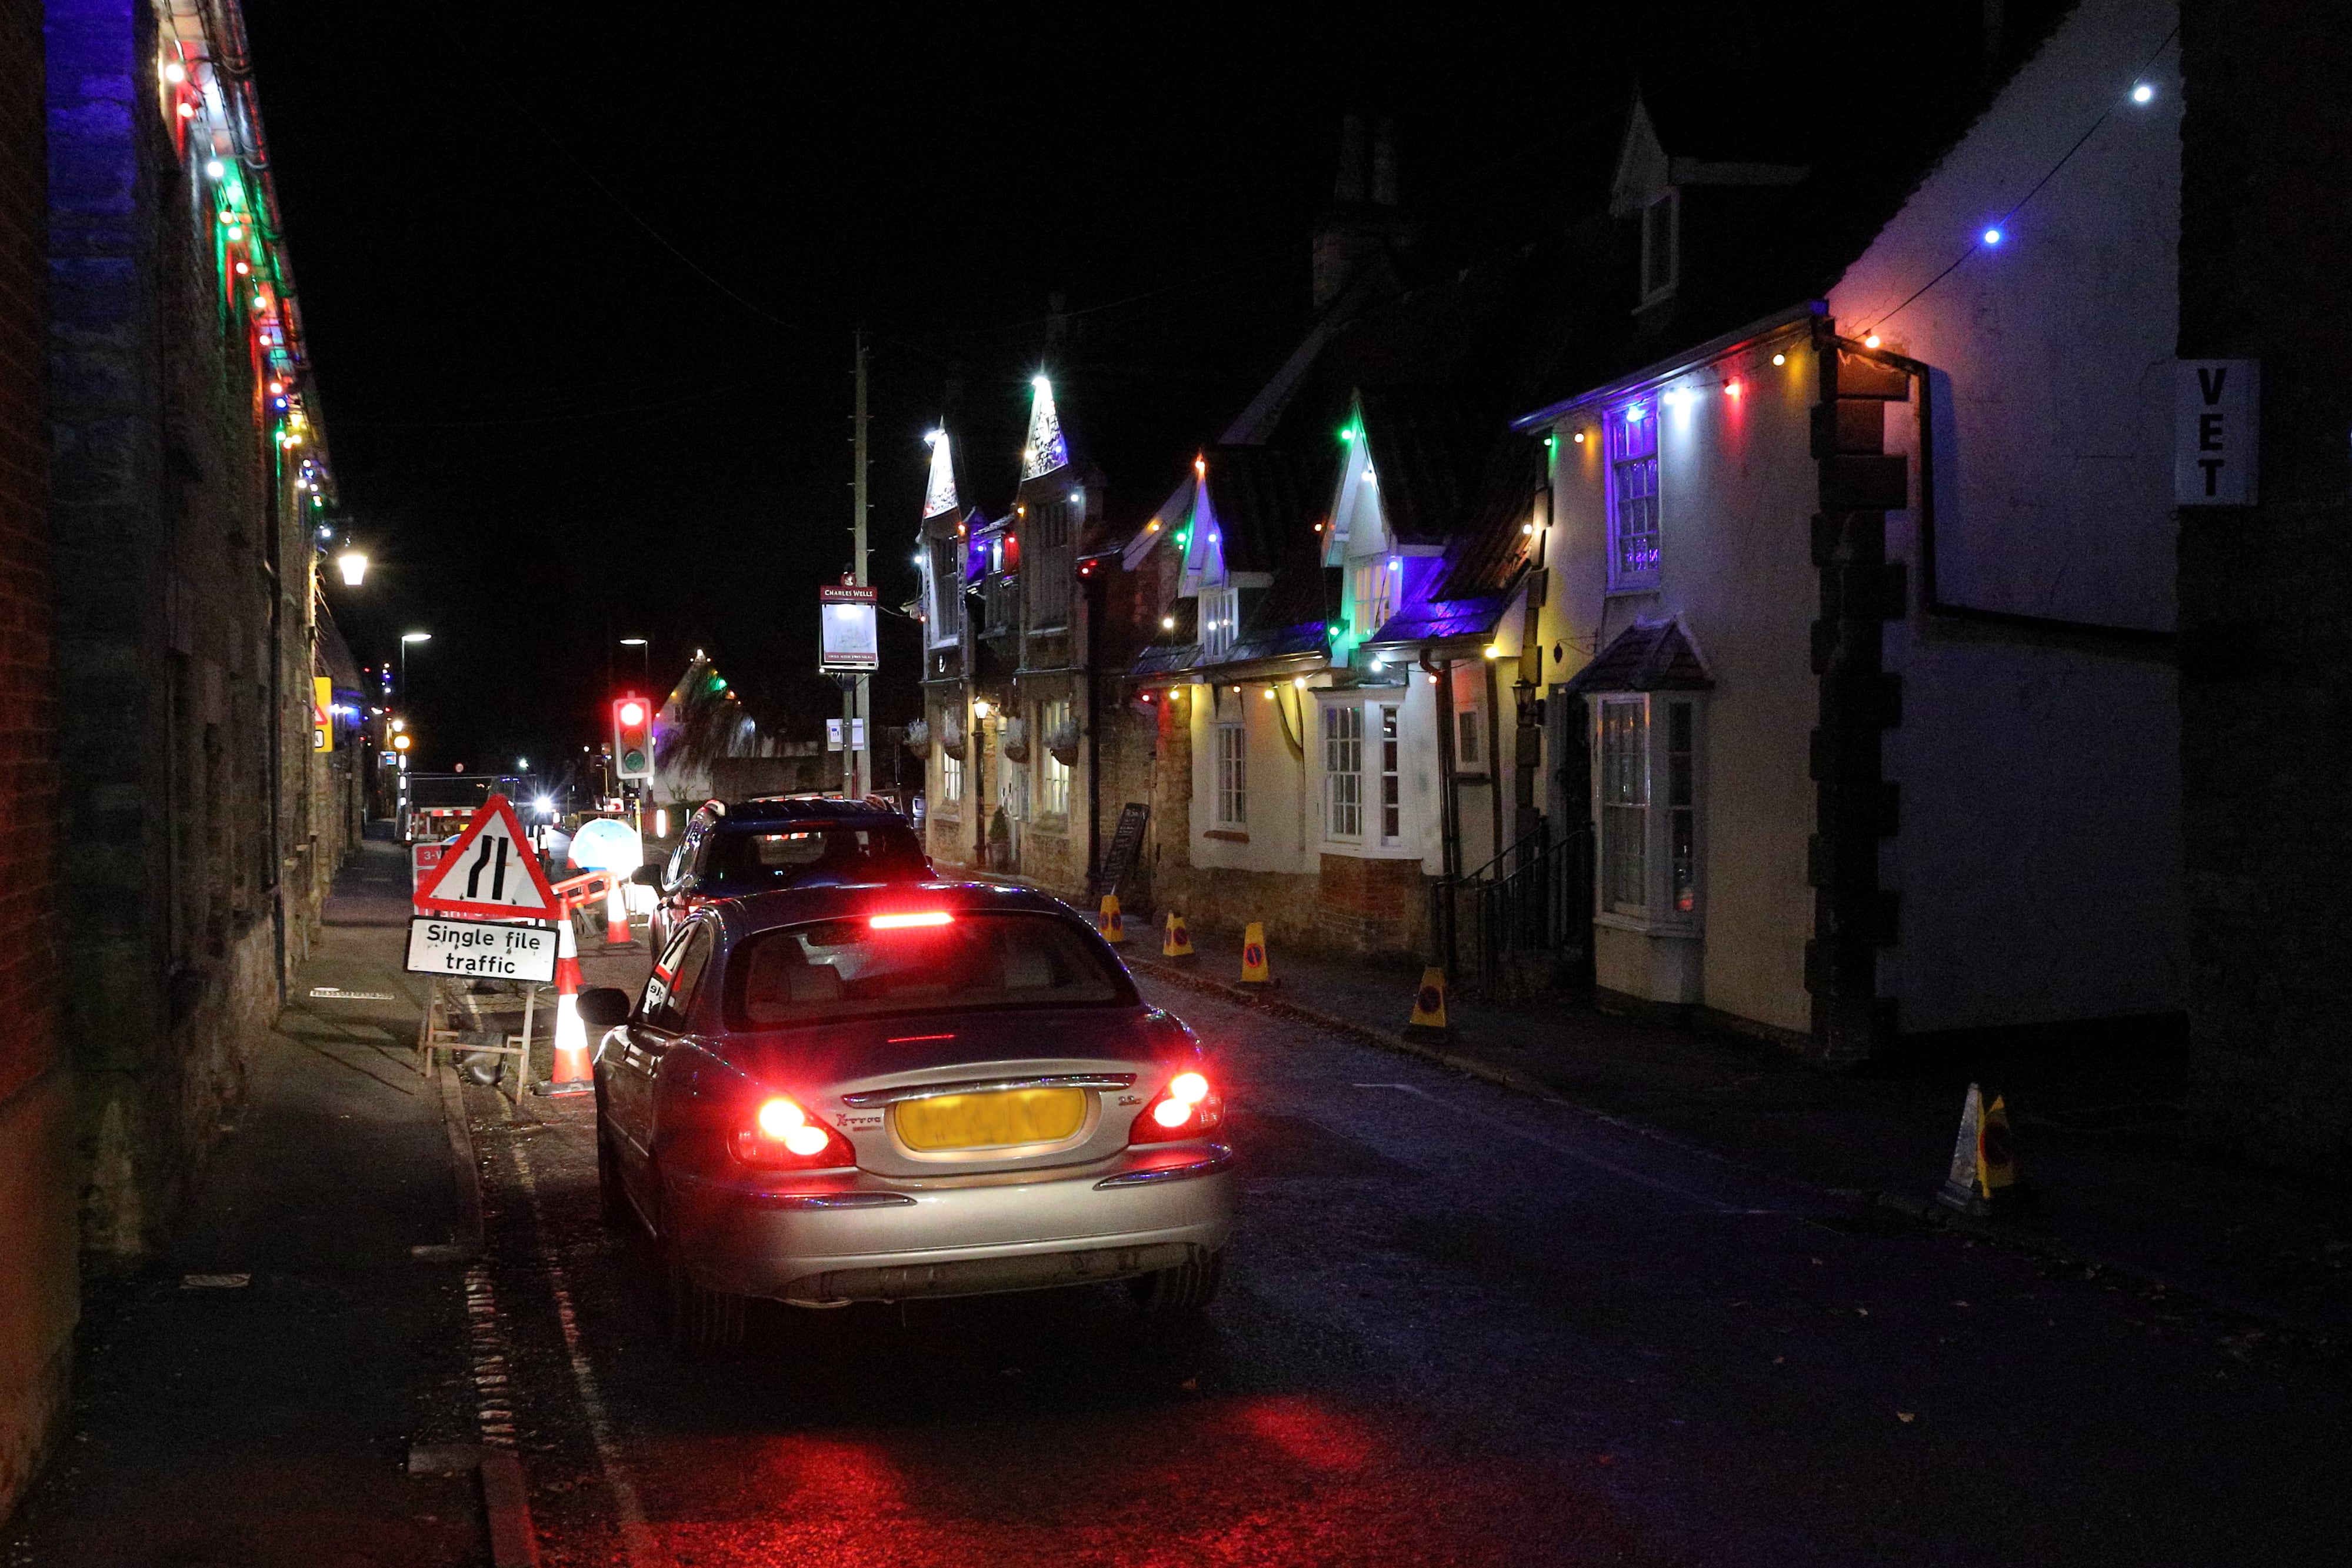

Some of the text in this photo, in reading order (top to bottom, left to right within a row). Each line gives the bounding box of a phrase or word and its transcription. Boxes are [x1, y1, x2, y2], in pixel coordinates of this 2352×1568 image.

[2197, 368, 2227, 496] VET
[427, 924, 541, 950] Single file
[446, 952, 516, 974] traffic
